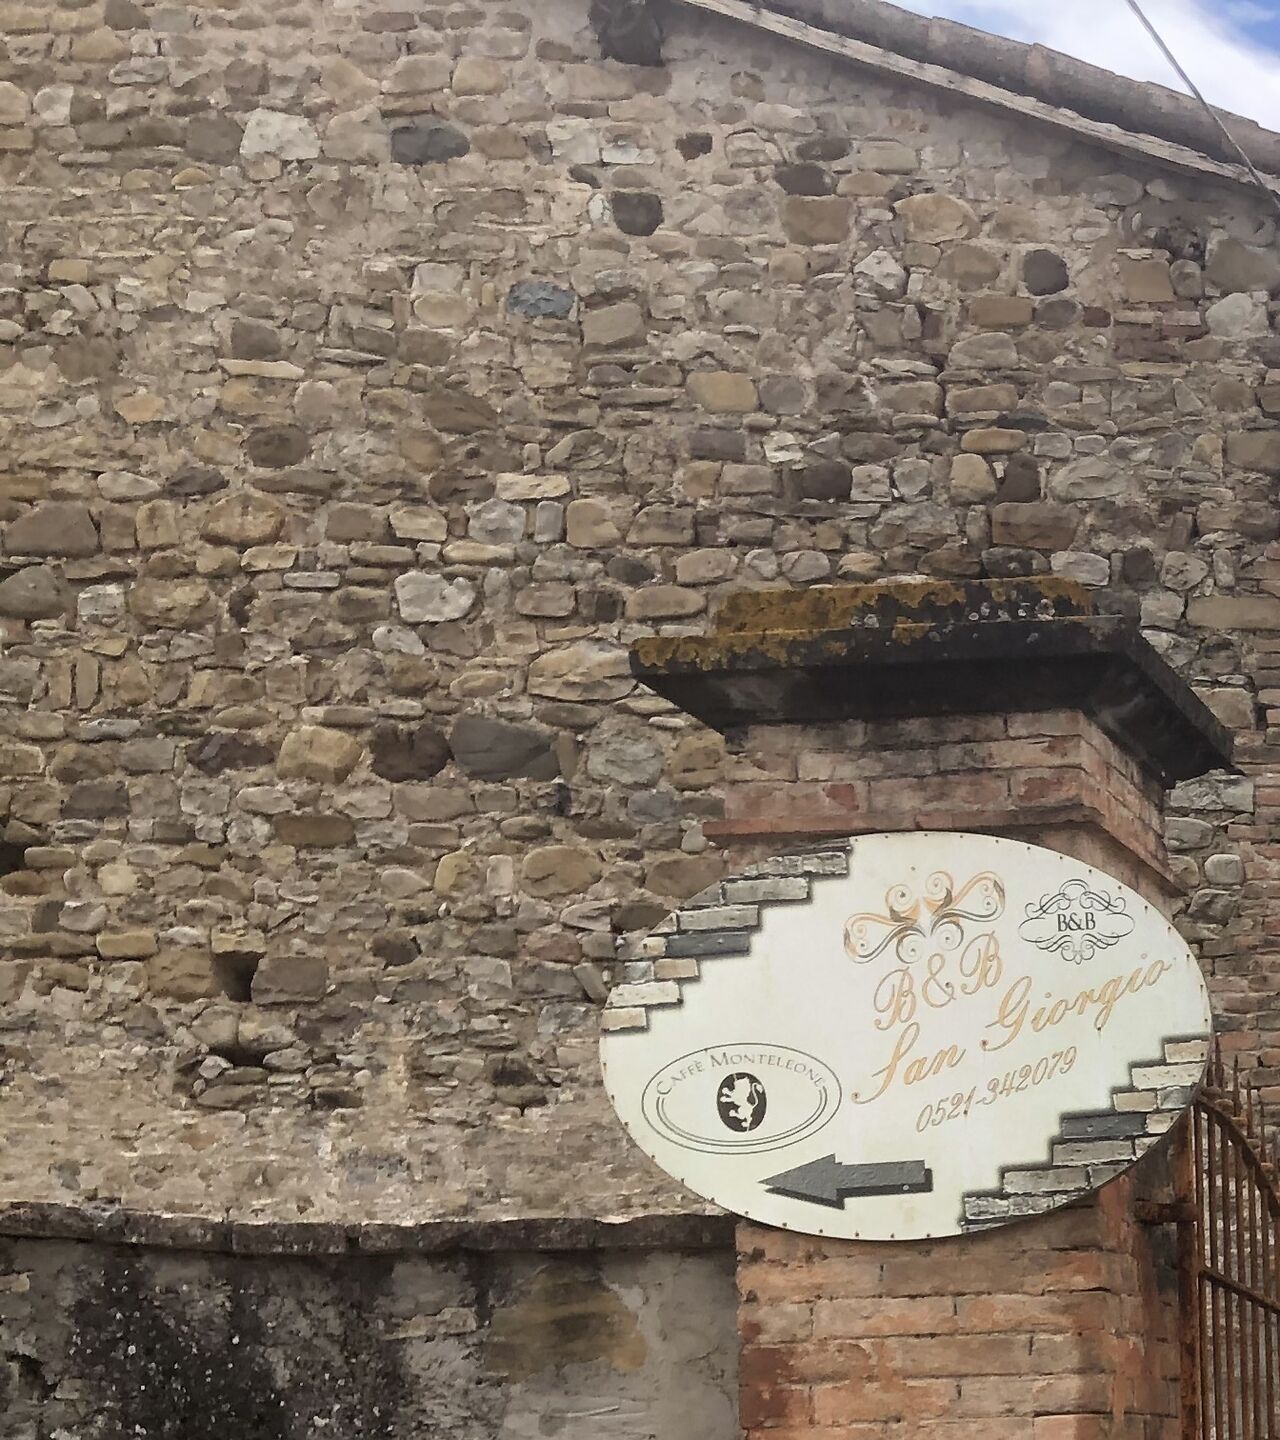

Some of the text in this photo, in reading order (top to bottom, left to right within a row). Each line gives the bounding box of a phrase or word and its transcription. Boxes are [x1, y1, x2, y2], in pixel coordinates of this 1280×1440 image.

[1057, 912, 1096, 932] B&B
[874, 933, 1003, 1031] B&B
[709, 1052, 827, 1088] MONTELEONE
[852, 953, 1172, 1105] San Giorgio
[916, 1046, 1077, 1133] 0521-342079
